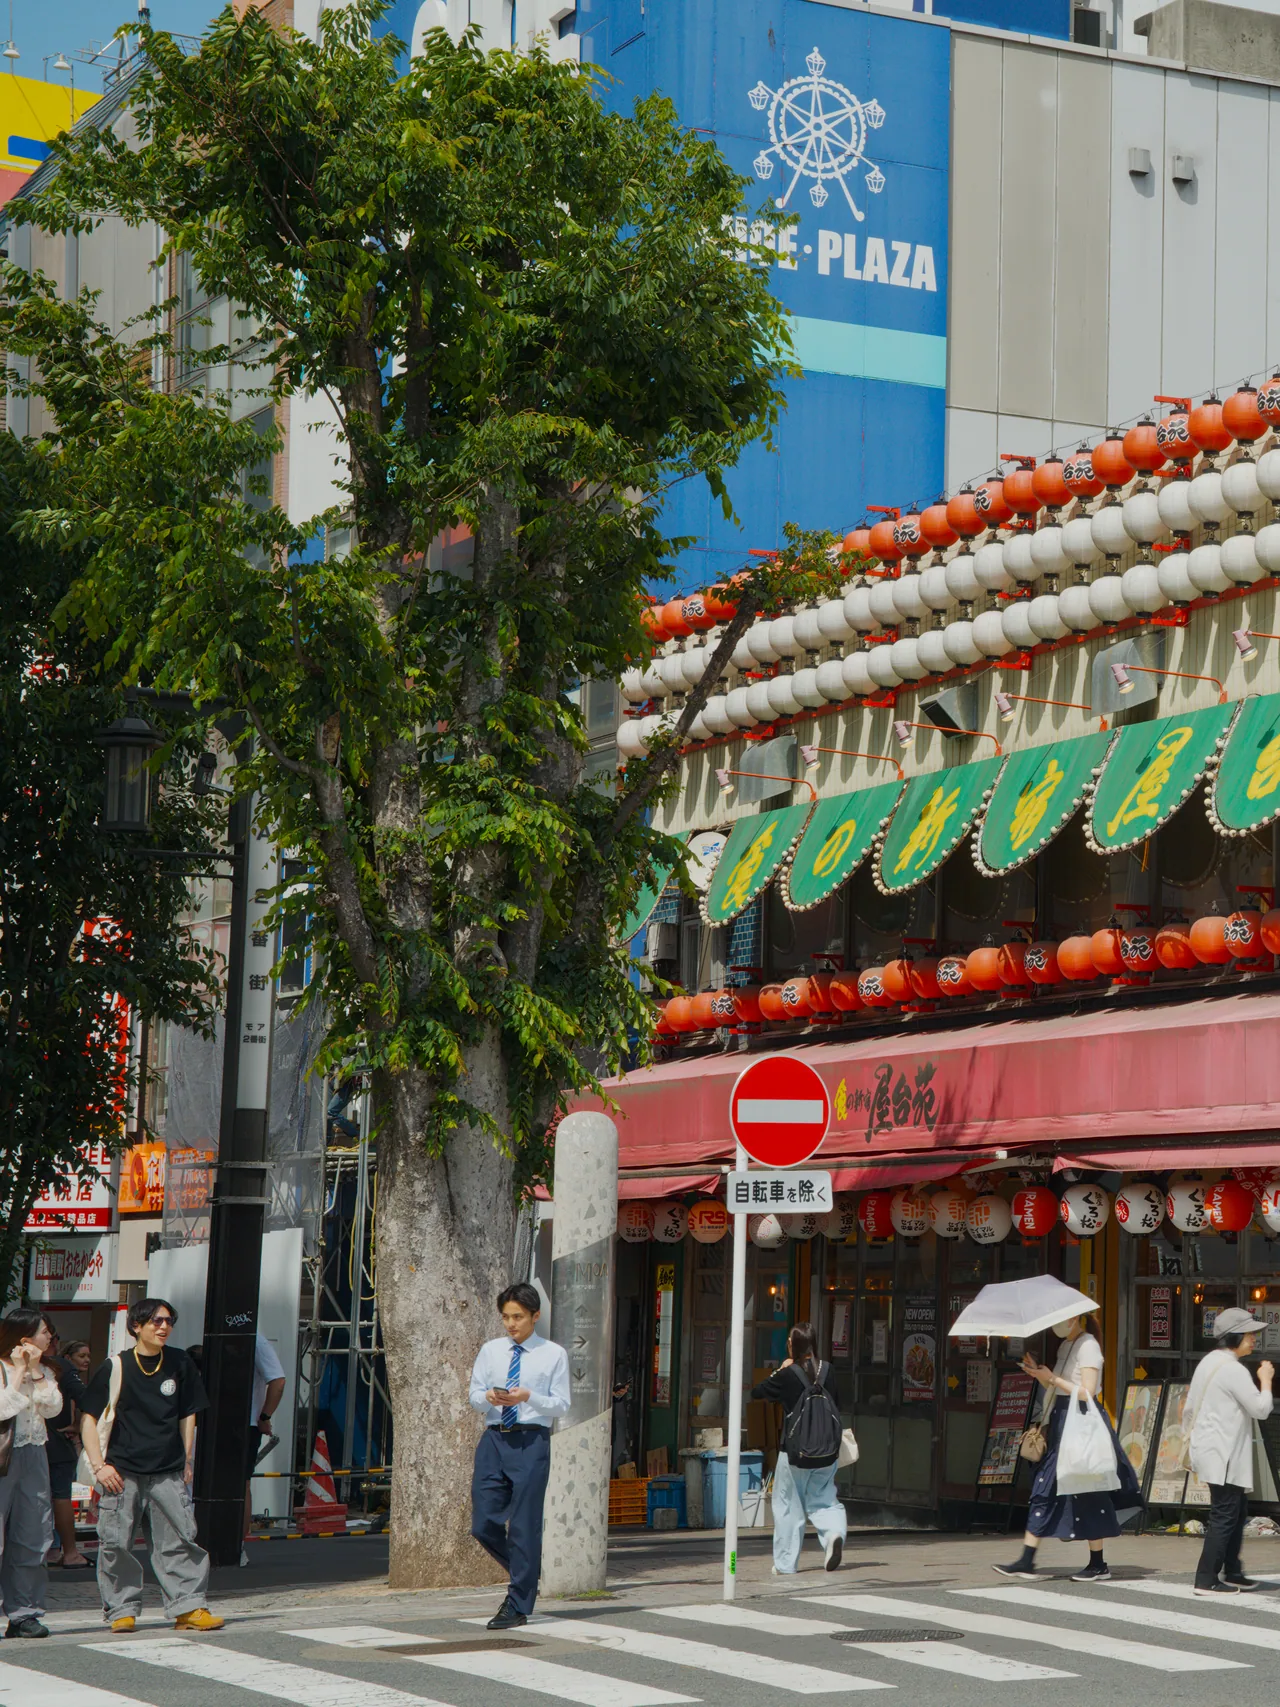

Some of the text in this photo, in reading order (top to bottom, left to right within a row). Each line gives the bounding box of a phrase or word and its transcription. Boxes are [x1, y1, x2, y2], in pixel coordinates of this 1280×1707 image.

[817, 229, 938, 292] PLAZA
[735, 1180, 826, 1204] 自転車を除く
[1139, 1190, 1160, 1228] くろ松
[1212, 1186, 1224, 1224] RAMEN
[699, 1210, 726, 1225] RS
[866, 1200, 877, 1233] RAMEN
[1023, 1192, 1036, 1230] RAMEN
[1080, 1191, 1099, 1229] くろ松
[65, 1248, 104, 1278] おたからや
[904, 1308, 919, 1321] NEW
